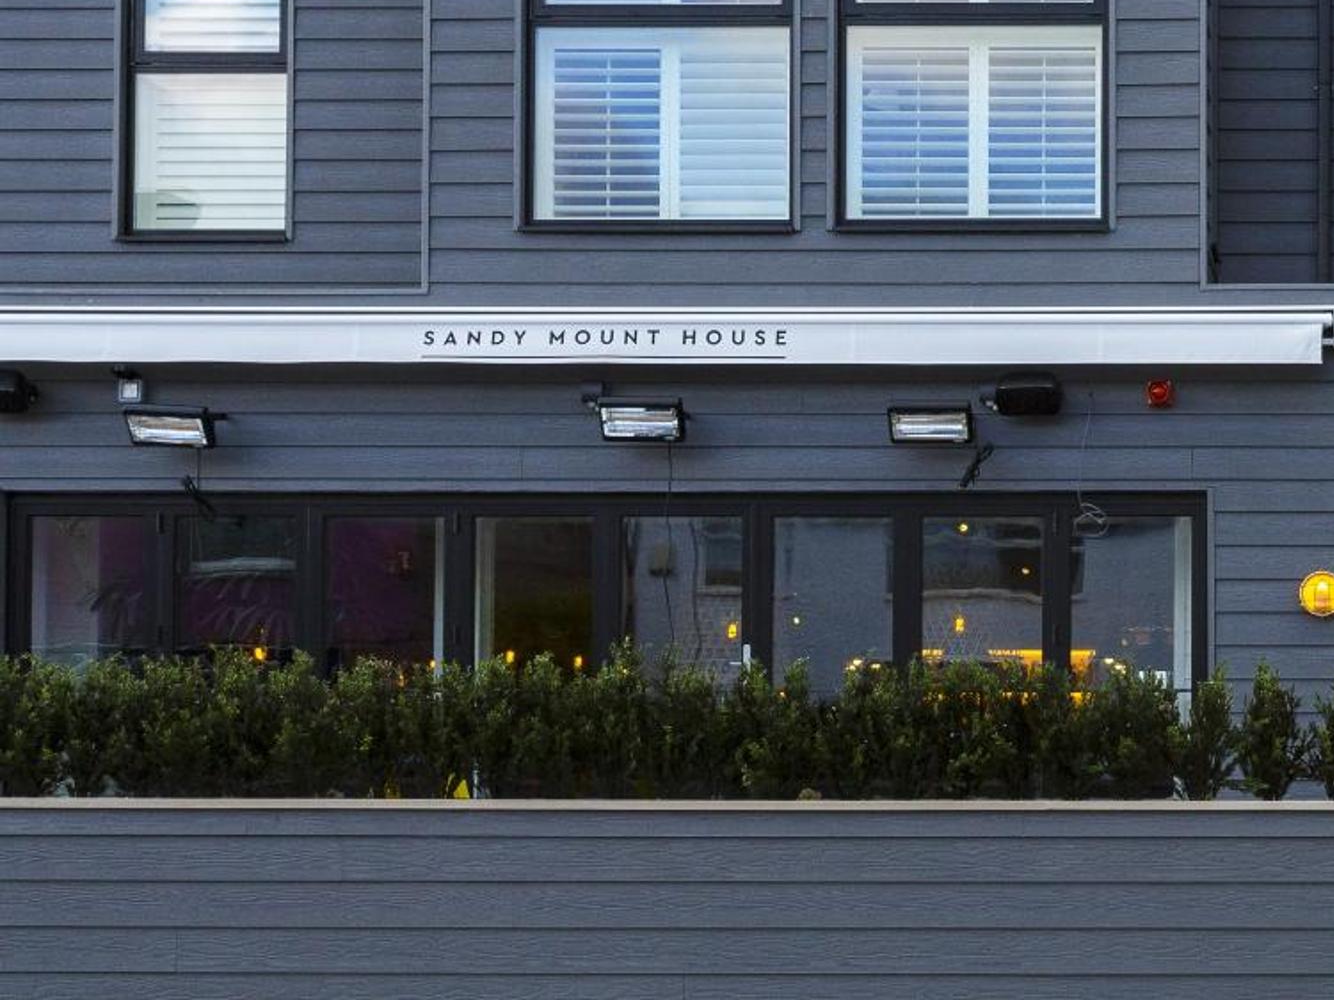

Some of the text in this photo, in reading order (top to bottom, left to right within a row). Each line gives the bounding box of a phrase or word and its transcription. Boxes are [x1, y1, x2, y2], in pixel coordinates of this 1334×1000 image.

[423, 329, 788, 346] SANDY MOUNT HOUSE
